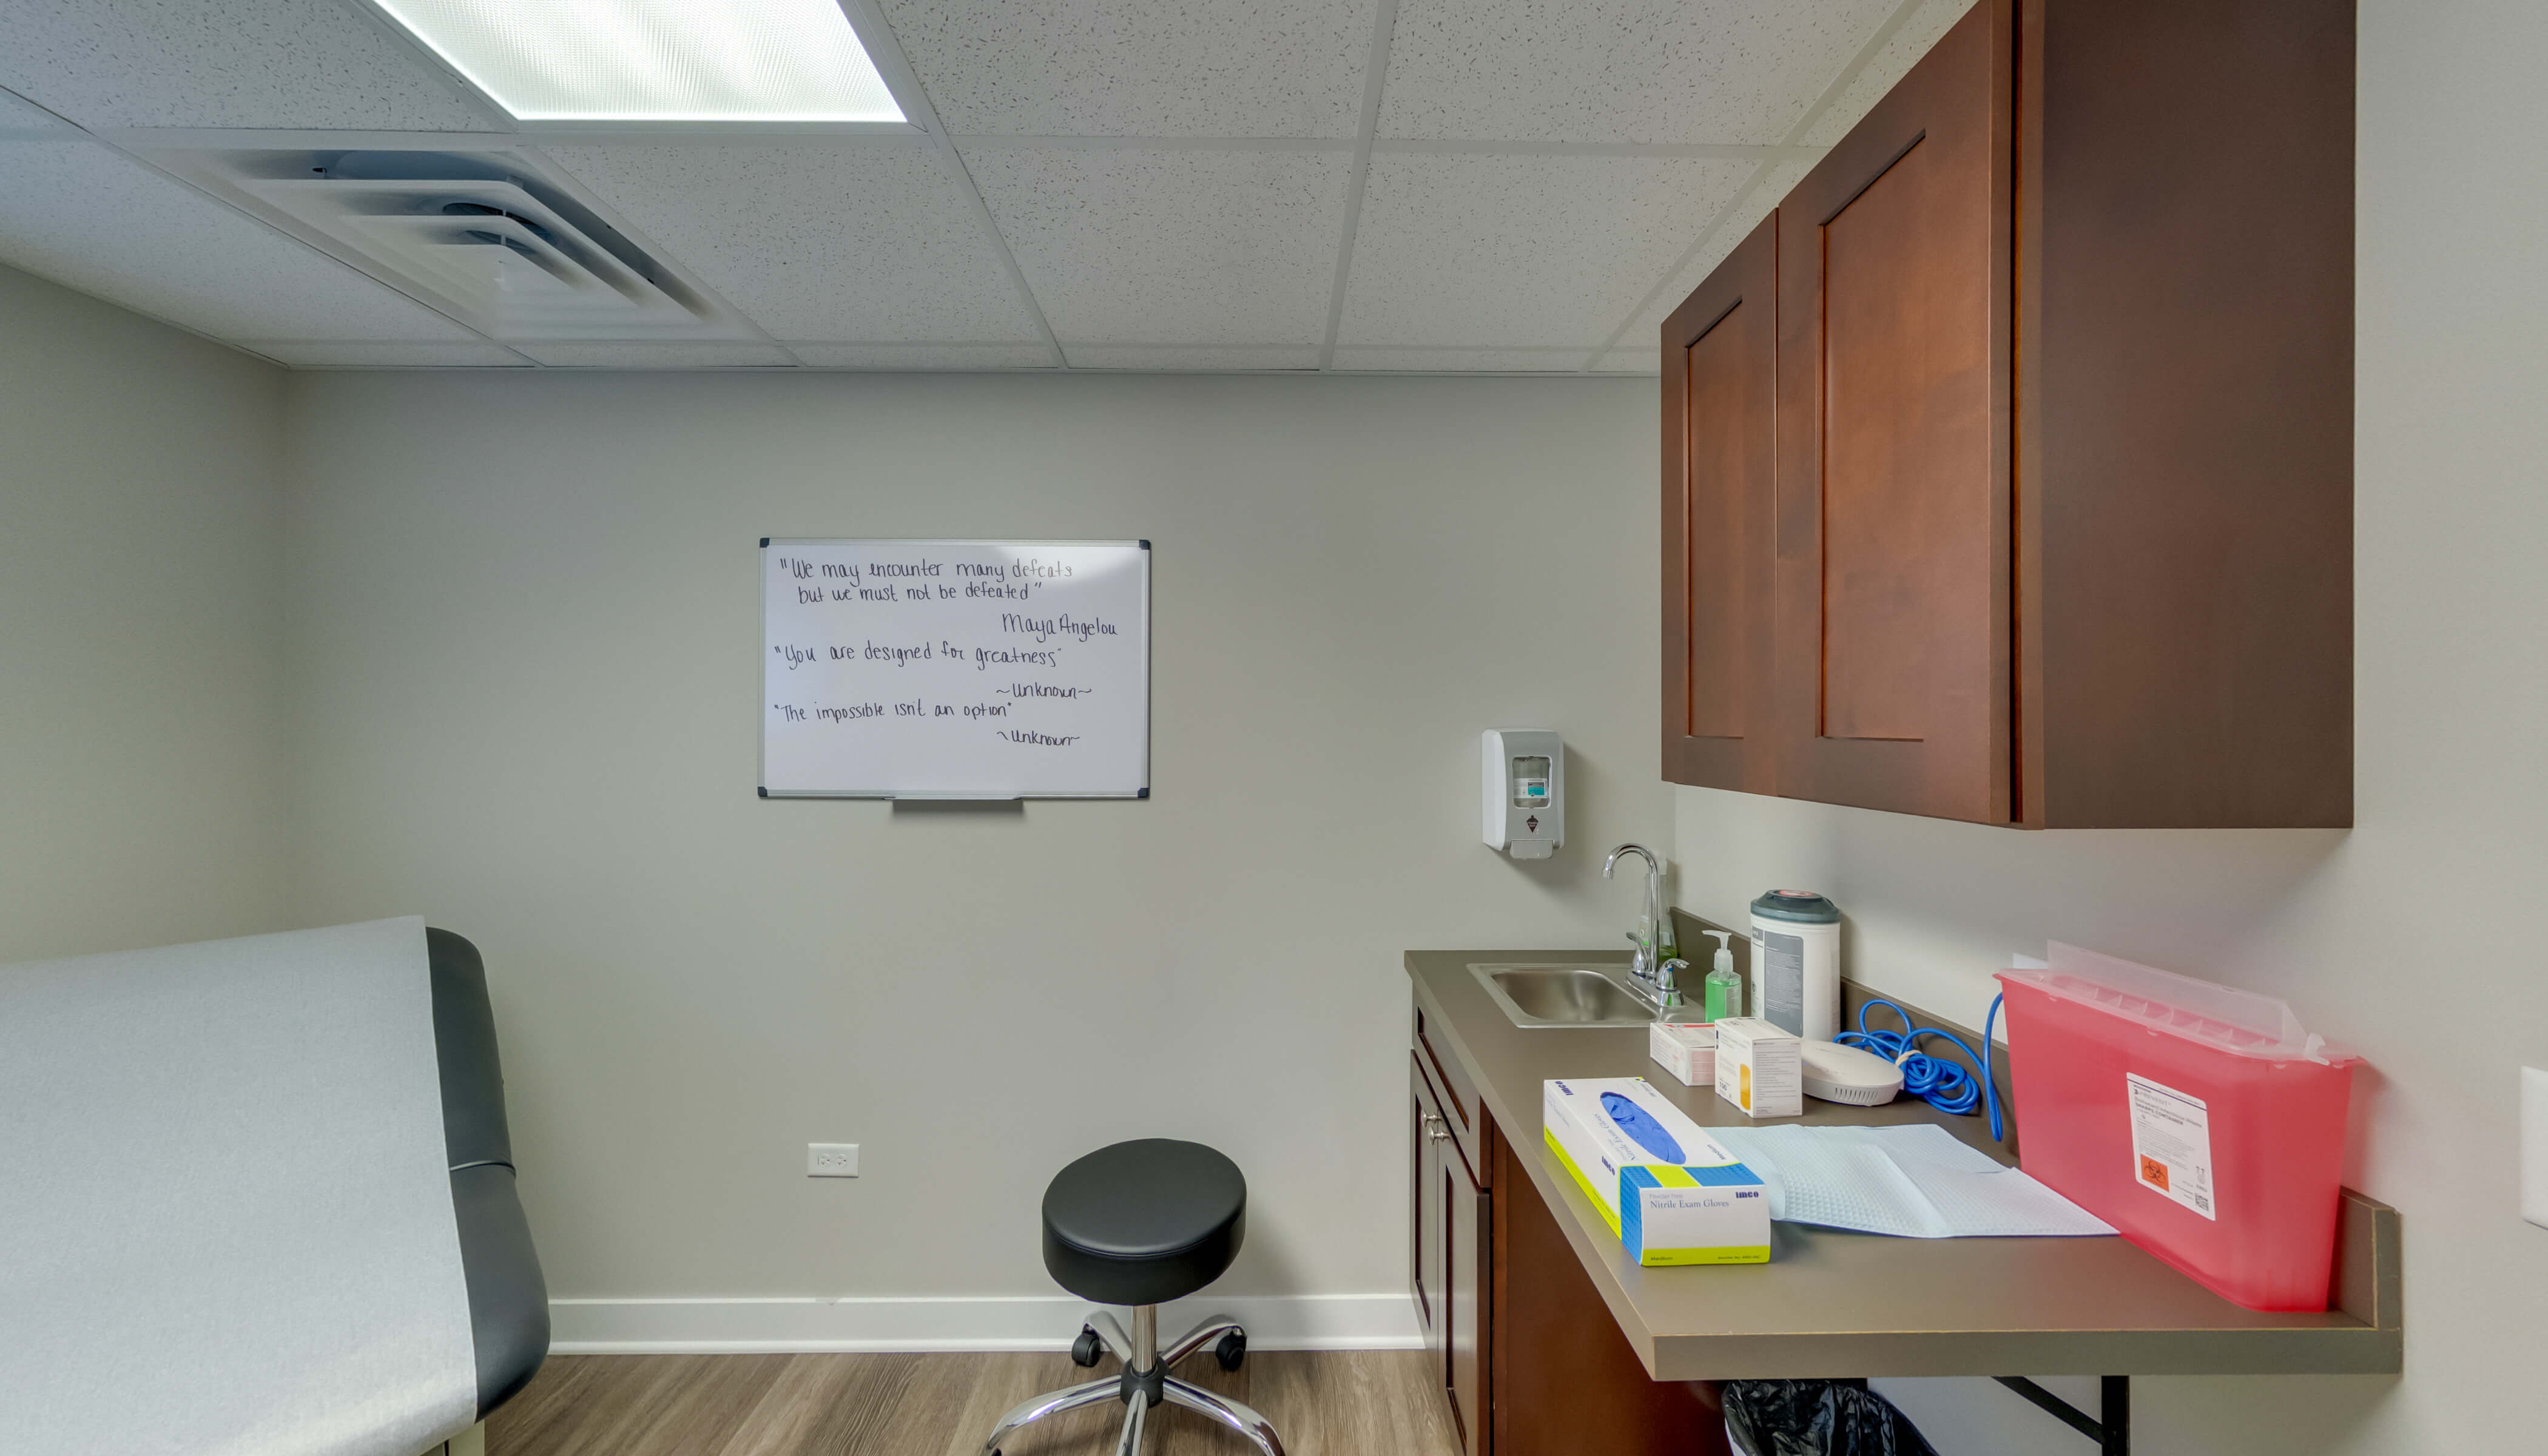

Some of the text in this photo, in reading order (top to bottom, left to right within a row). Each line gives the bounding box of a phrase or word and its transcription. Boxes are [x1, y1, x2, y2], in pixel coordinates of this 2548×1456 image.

[822, 563, 860, 587] may
[869, 558, 943, 577] encounter
[956, 563, 1005, 582] many
[1013, 558, 1073, 578] defeats
[798, 586, 825, 604] but
[832, 588, 853, 601] we
[860, 584, 898, 602] must
[907, 584, 931, 600] not
[940, 584, 957, 599] be
[1002, 613, 1119, 643] Maya Angelou
[830, 646, 855, 660] are
[864, 640, 932, 667] designed
[942, 641, 965, 660] for
[815, 701, 885, 723] impossible
[935, 704, 955, 717] an
[1650, 1198, 1729, 1209] Nitrile Exam Gloves
